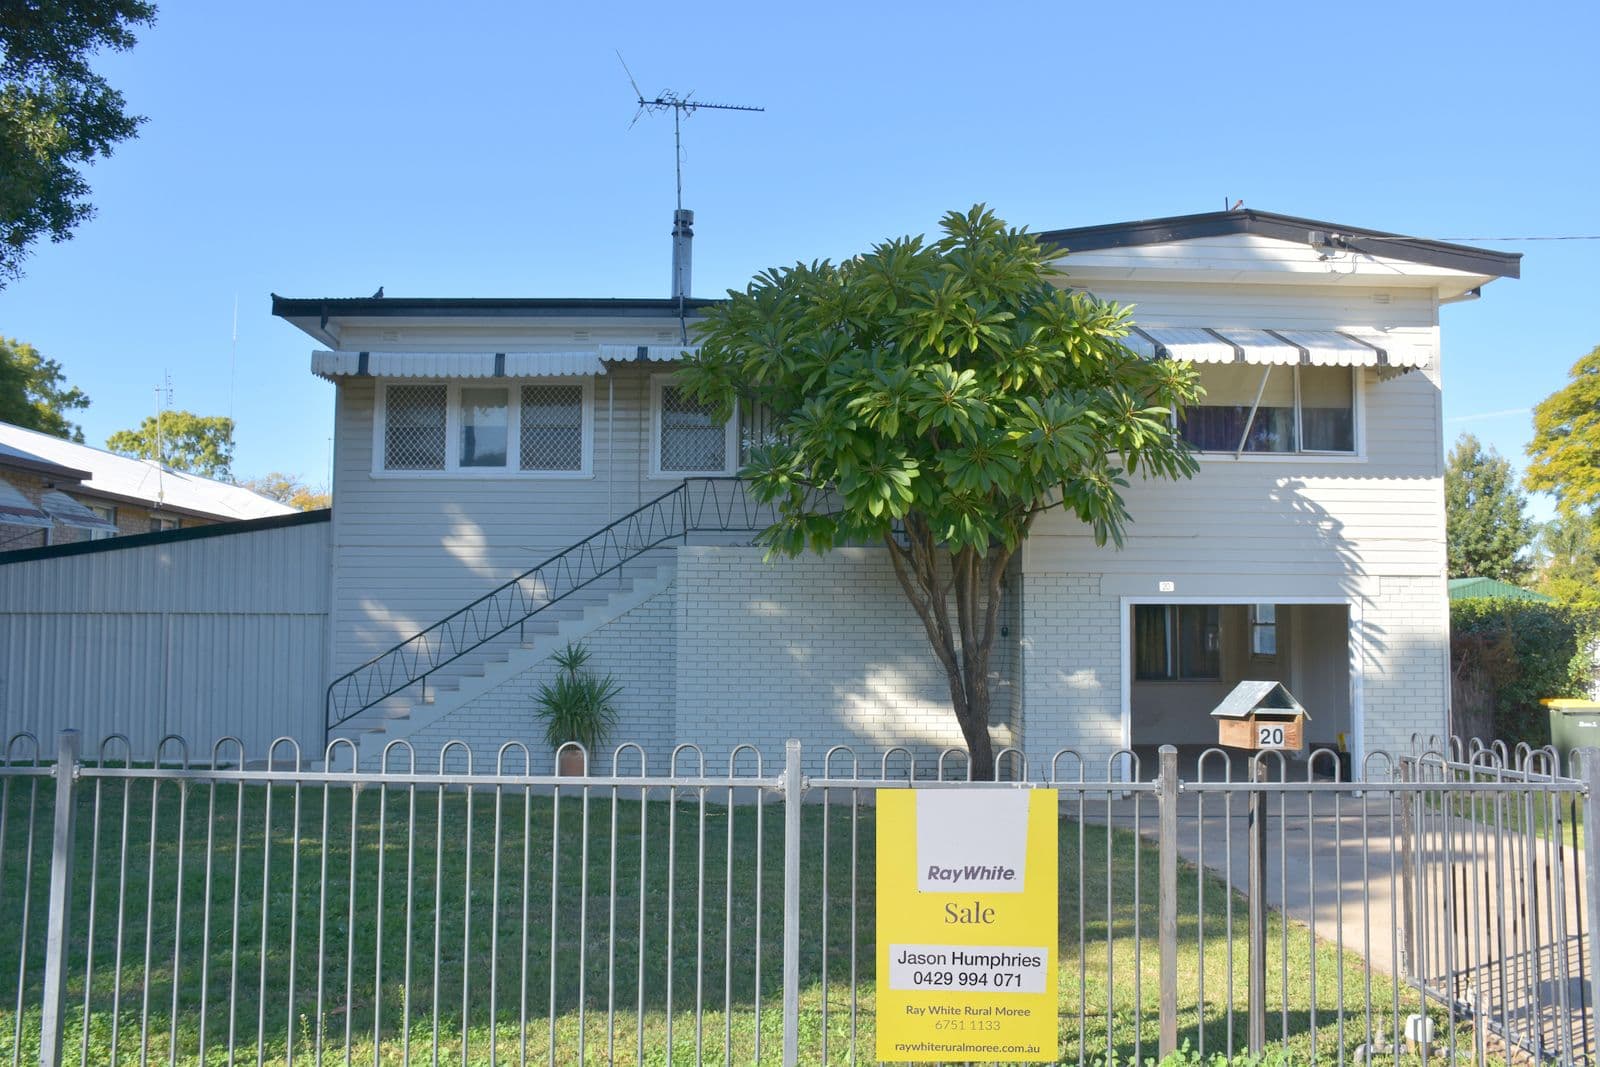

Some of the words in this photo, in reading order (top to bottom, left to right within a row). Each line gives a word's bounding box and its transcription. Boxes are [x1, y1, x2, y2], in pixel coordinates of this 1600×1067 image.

[1260, 728, 1283, 745] 20
[944, 901, 996, 925] Sale
[897, 950, 947, 965] Jason
[951, 951, 1041, 969] Humphries
[913, 971, 953, 985] 0429
[958, 972, 988, 986] 994
[993, 973, 1022, 987] 071
[906, 1005, 926, 1016] Ray
[928, 1006, 961, 1016] White
[964, 1006, 992, 1016] Rural
[995, 1007, 1031, 1017] Moree
[935, 1019, 964, 1031] 6751
[971, 1020, 1001, 1031] 1133
[895, 1042, 1040, 1054] raywhiteruralmoree.com.au
